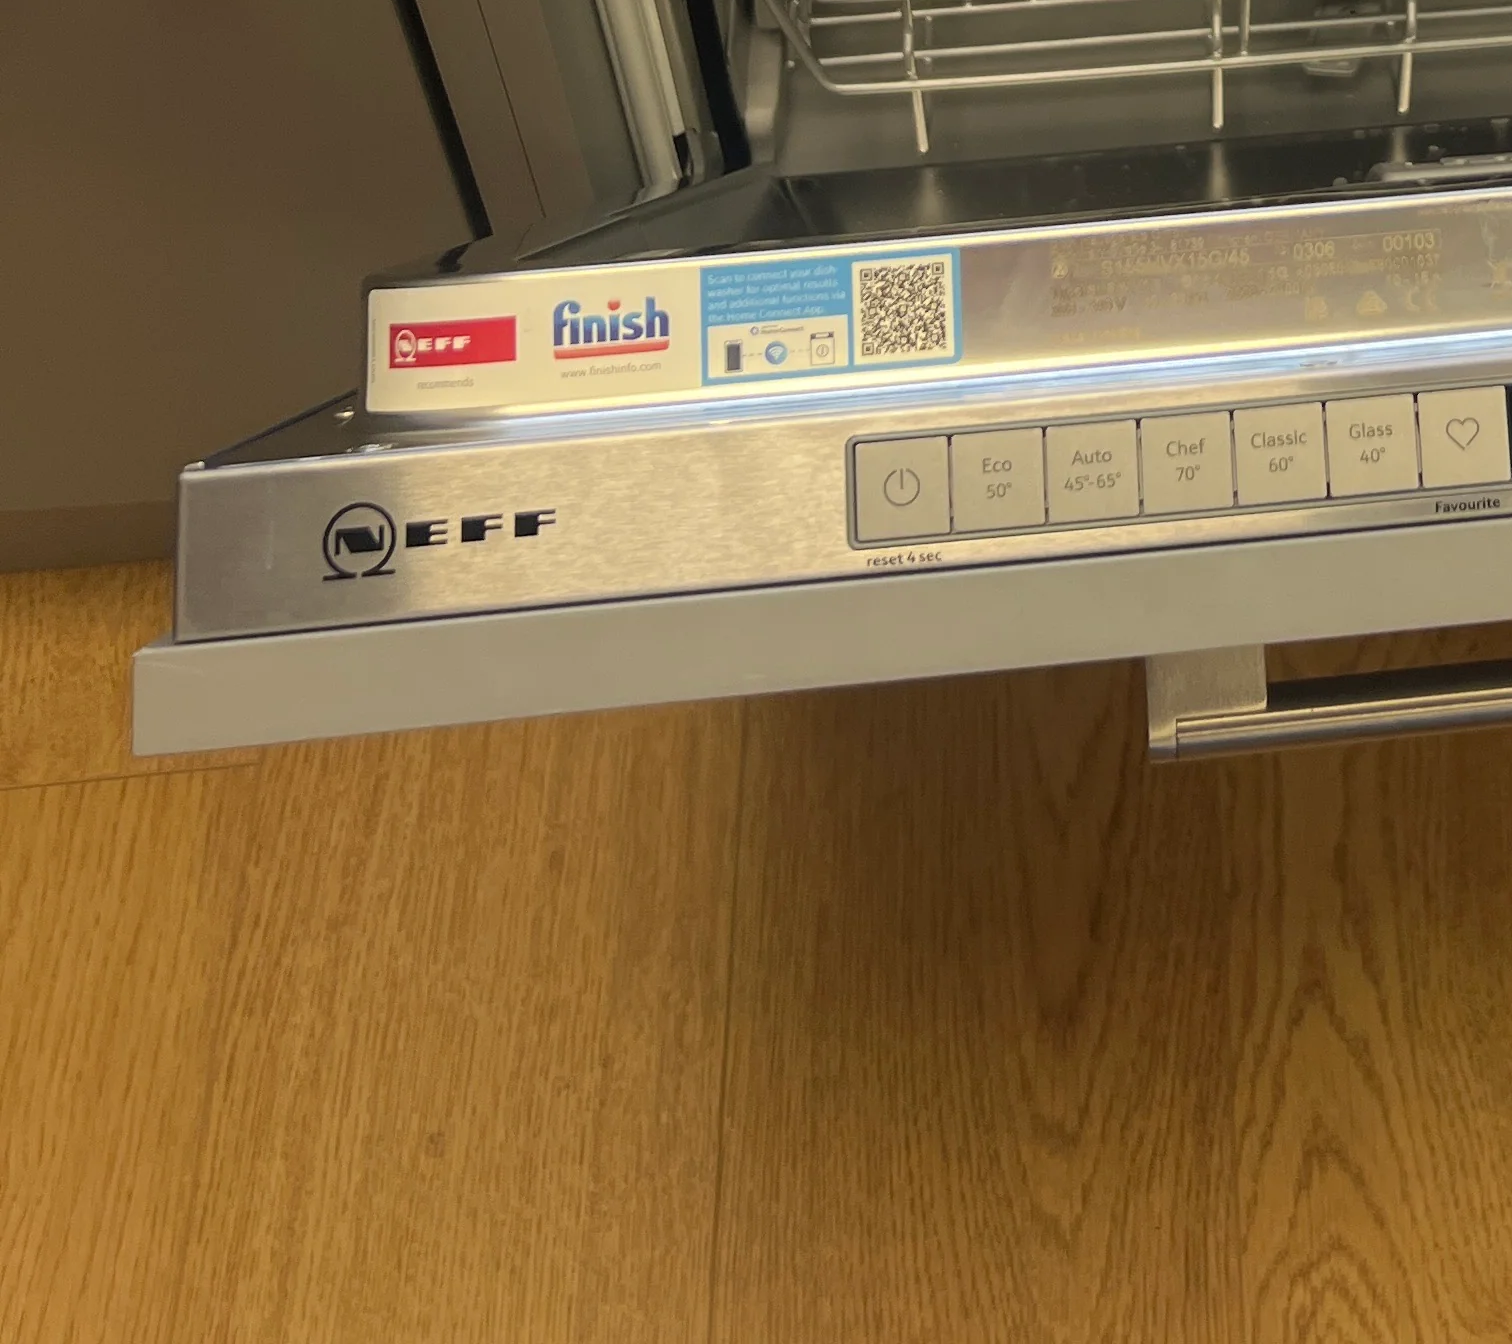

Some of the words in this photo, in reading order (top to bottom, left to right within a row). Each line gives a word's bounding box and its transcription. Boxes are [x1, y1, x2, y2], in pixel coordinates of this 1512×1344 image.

[1293, 240, 1335, 260] 0306
[1383, 232, 1435, 253] 00103
[553, 296, 670, 348] finish
[560, 361, 662, 379] www.finishinfo.com
[1250, 429, 1308, 450] Classic
[1349, 422, 1393, 440] Glass
[1166, 437, 1206, 457] Chef
[982, 457, 1013, 474] Eco
[1071, 450, 1112, 466] Auto
[1434, 496, 1501, 515] Favourite
[323, 502, 556, 576] NEFF
[866, 552, 903, 568] reset
[906, 551, 916, 564] 4
[919, 550, 942, 562] sec
